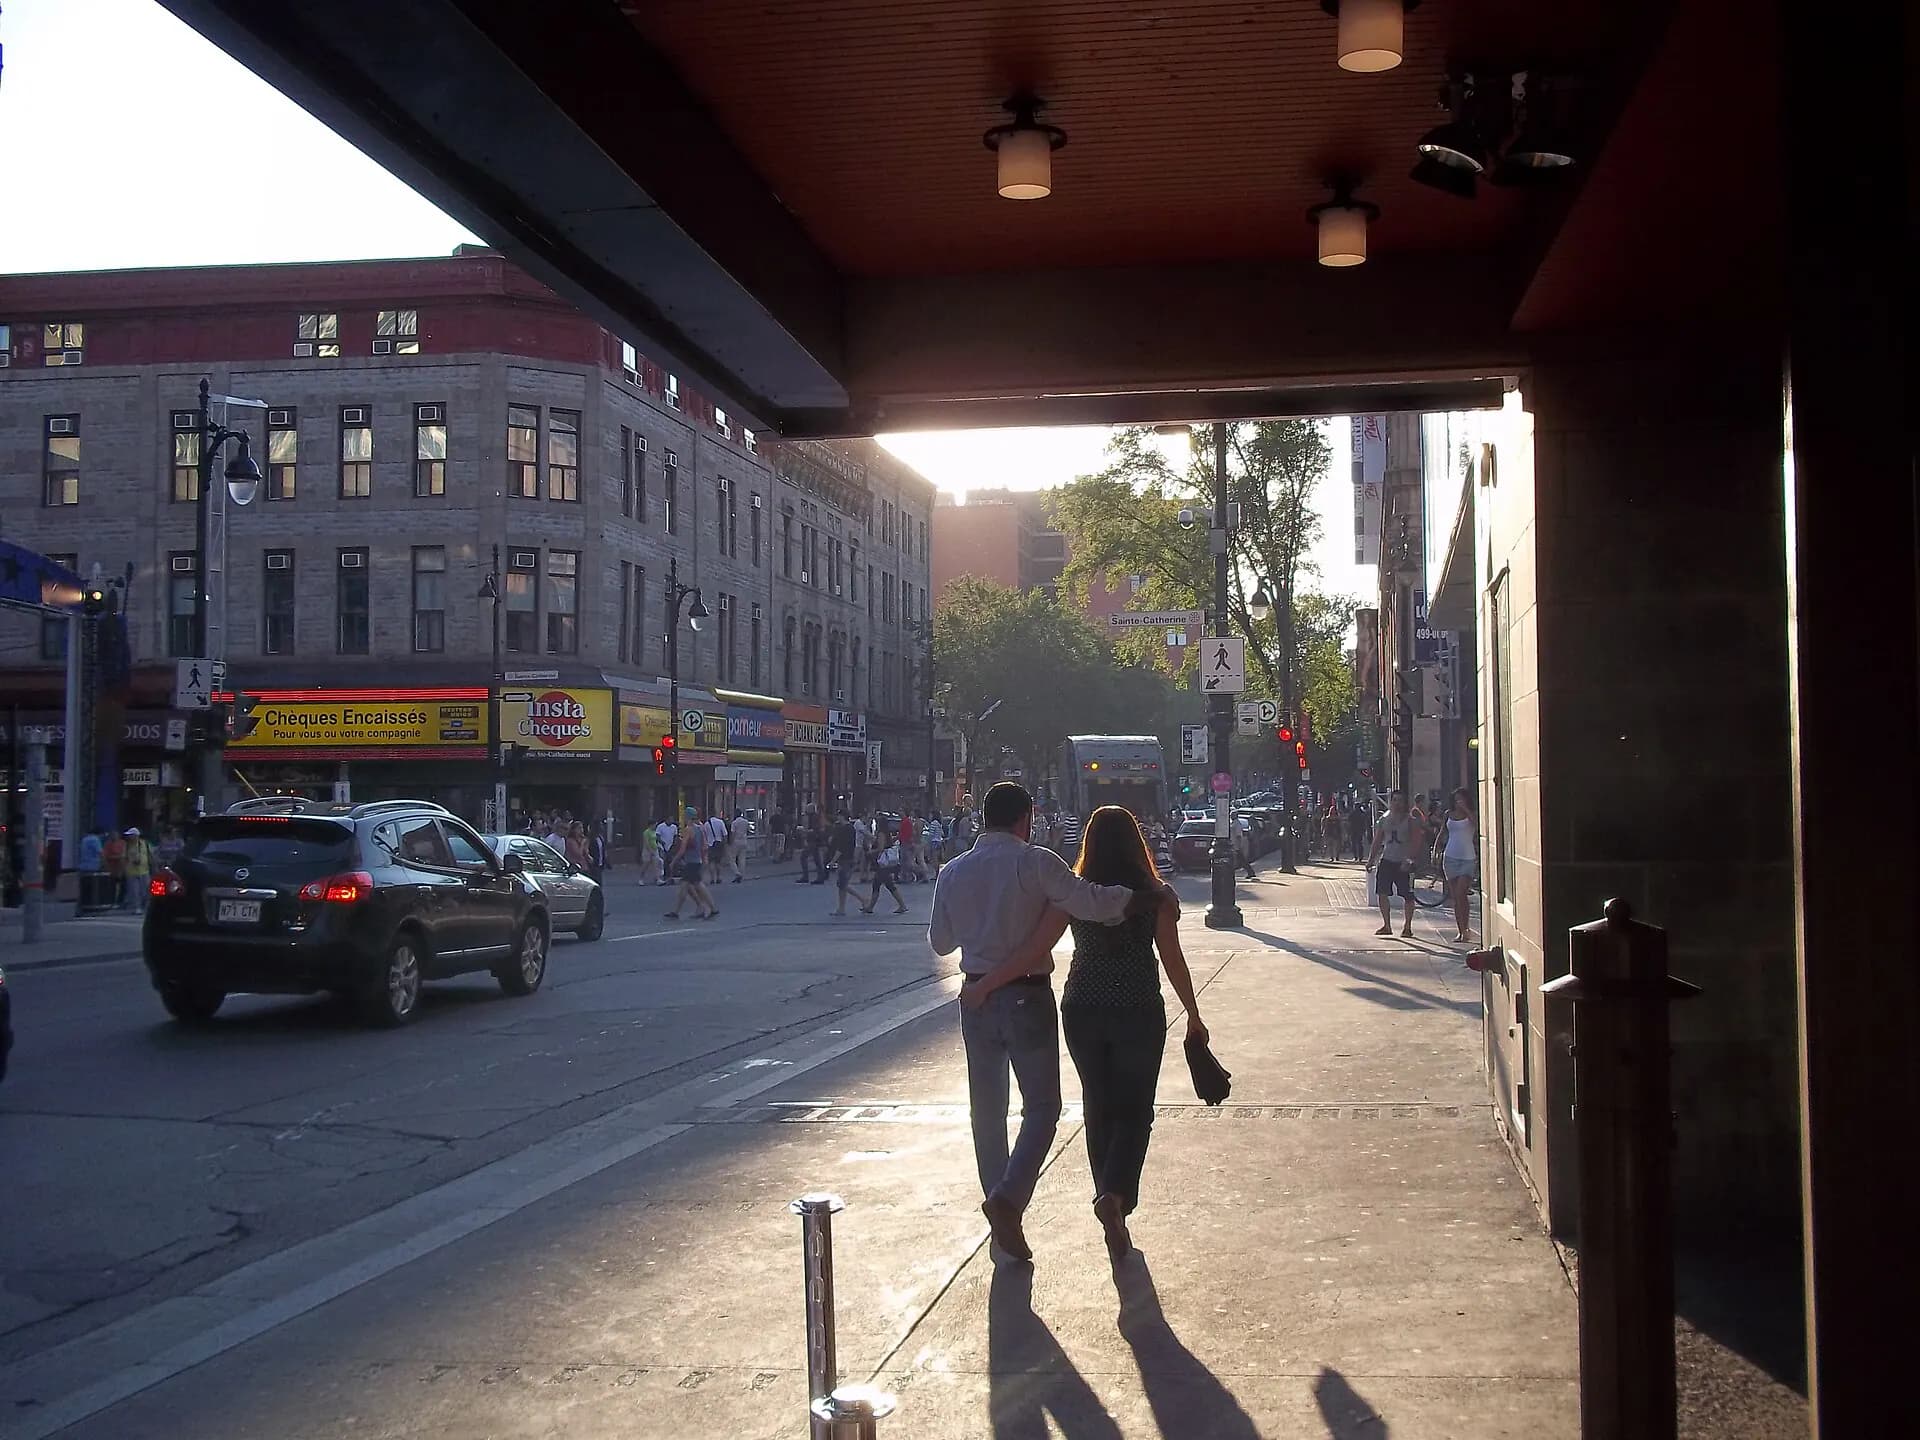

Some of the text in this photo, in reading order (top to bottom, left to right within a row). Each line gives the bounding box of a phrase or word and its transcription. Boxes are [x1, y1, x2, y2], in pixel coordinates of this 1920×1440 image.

[1111, 616, 1187, 625] Sainte-Catherine
[527, 698, 586, 718] Insta
[265, 708, 427, 729] Chèques Encaissés
[273, 728, 421, 739] Pour vous ou votre compagnie
[517, 719, 592, 739] Chèques
